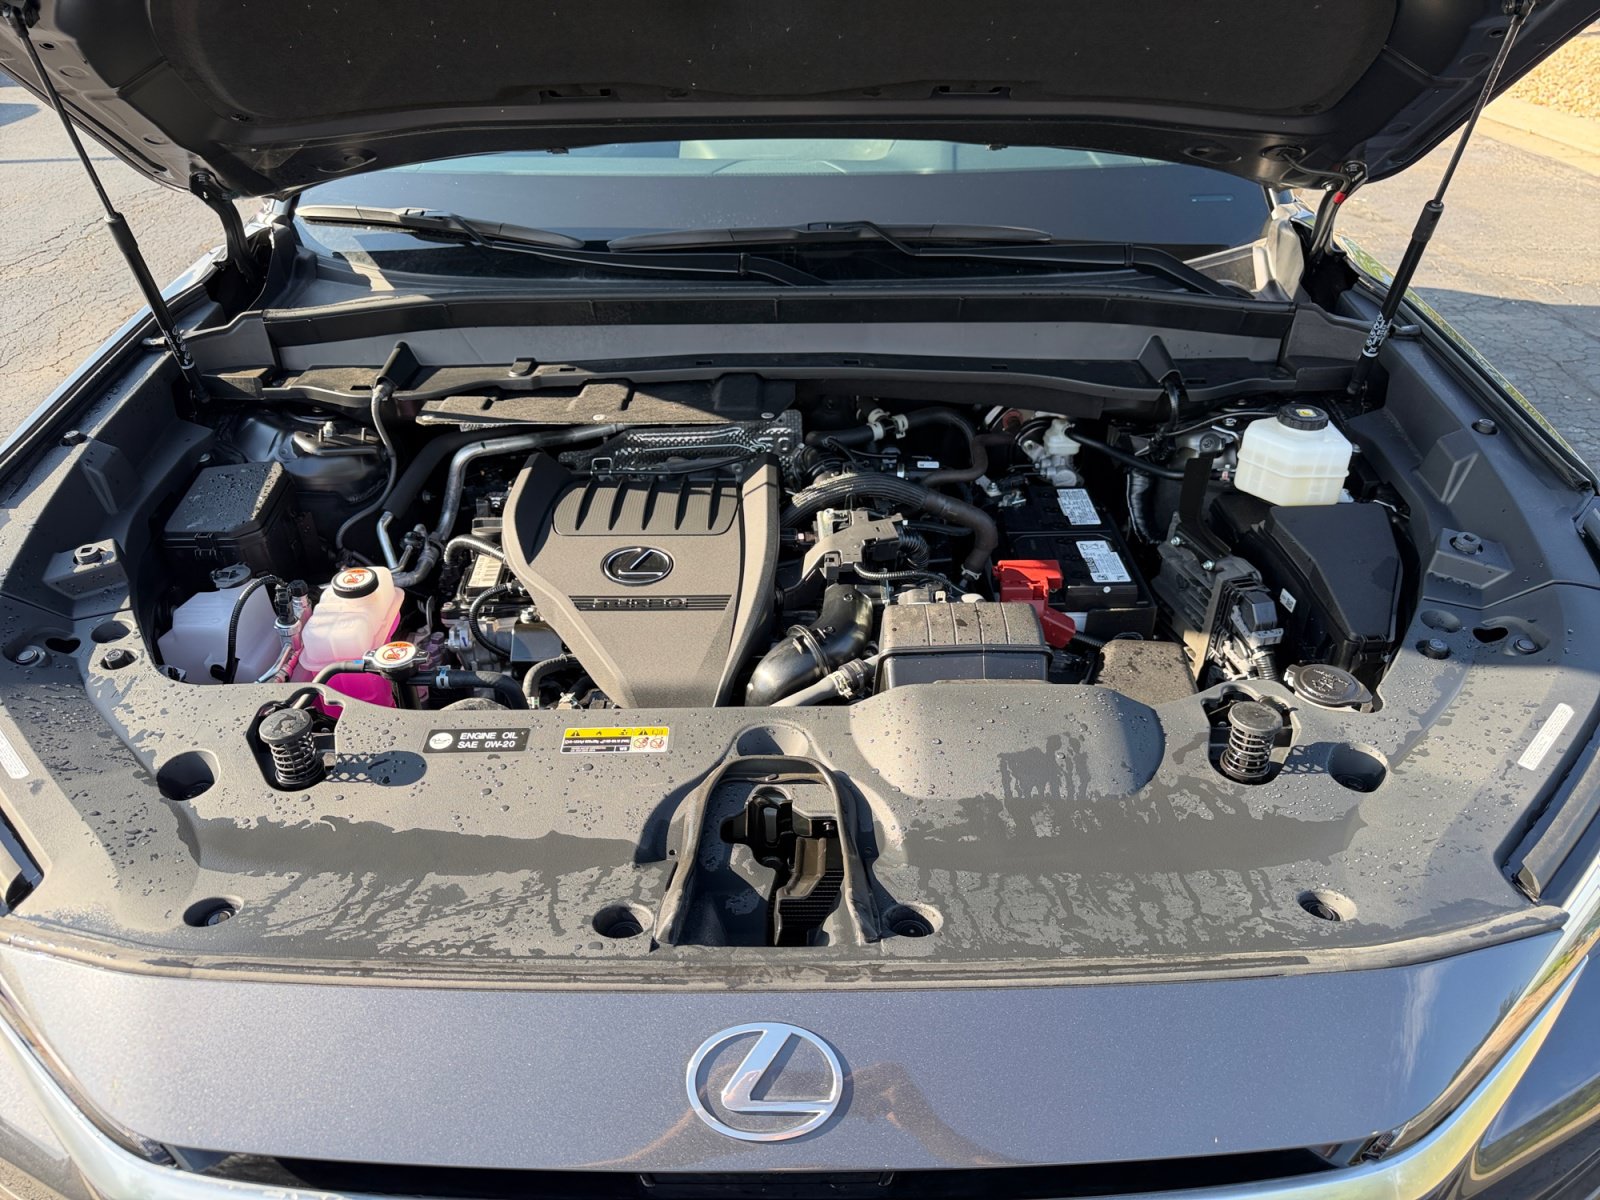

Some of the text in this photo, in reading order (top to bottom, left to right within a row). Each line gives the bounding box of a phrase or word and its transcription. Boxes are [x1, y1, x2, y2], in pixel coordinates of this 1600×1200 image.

[460, 731, 518, 740] ENGINE OIL
[457, 740, 516, 749] SAE 0W-20
